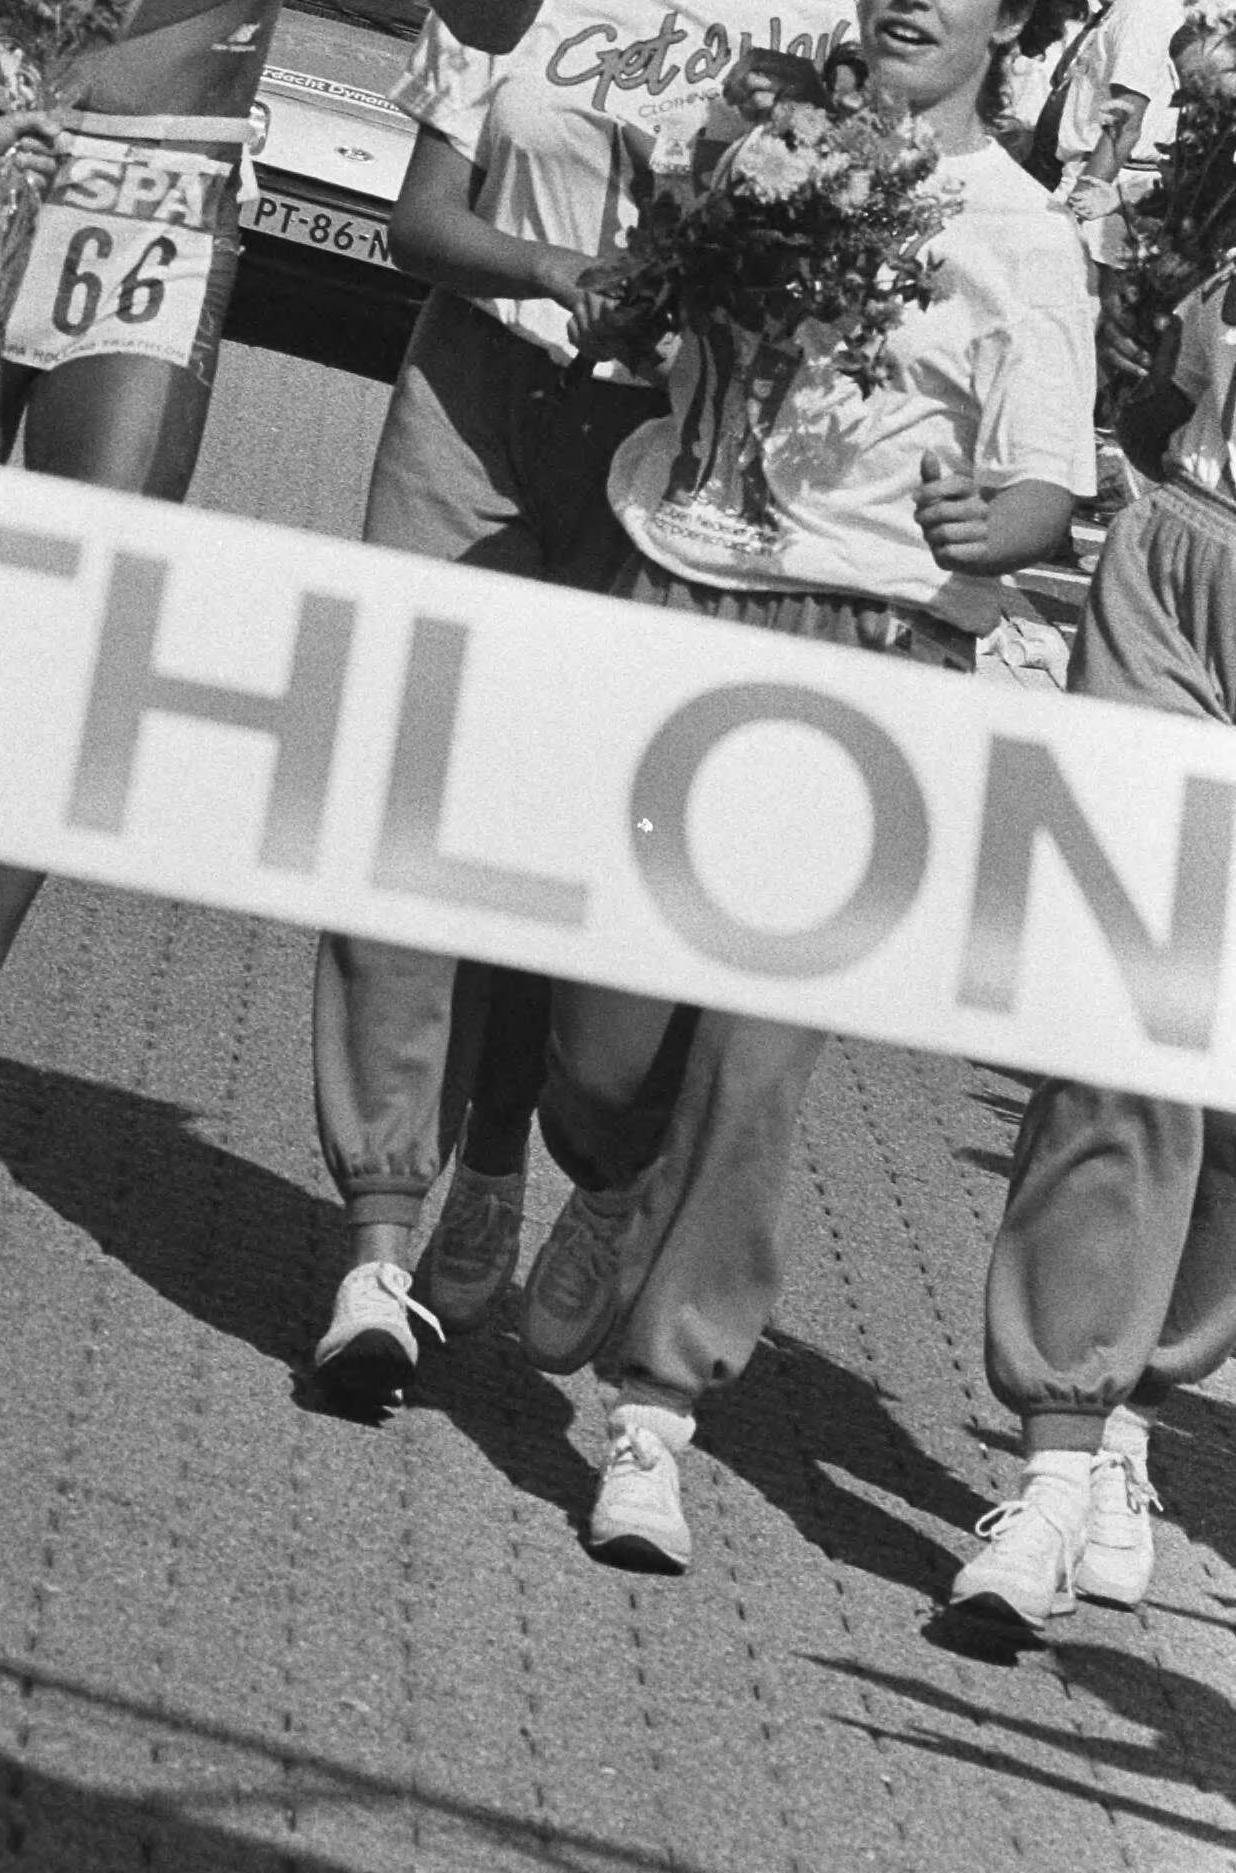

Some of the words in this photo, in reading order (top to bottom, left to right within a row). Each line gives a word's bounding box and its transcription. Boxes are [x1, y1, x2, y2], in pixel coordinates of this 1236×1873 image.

[546, 12, 688, 112] Get
[64, 158, 204, 227] SPA
[52, 226, 178, 337] 66
